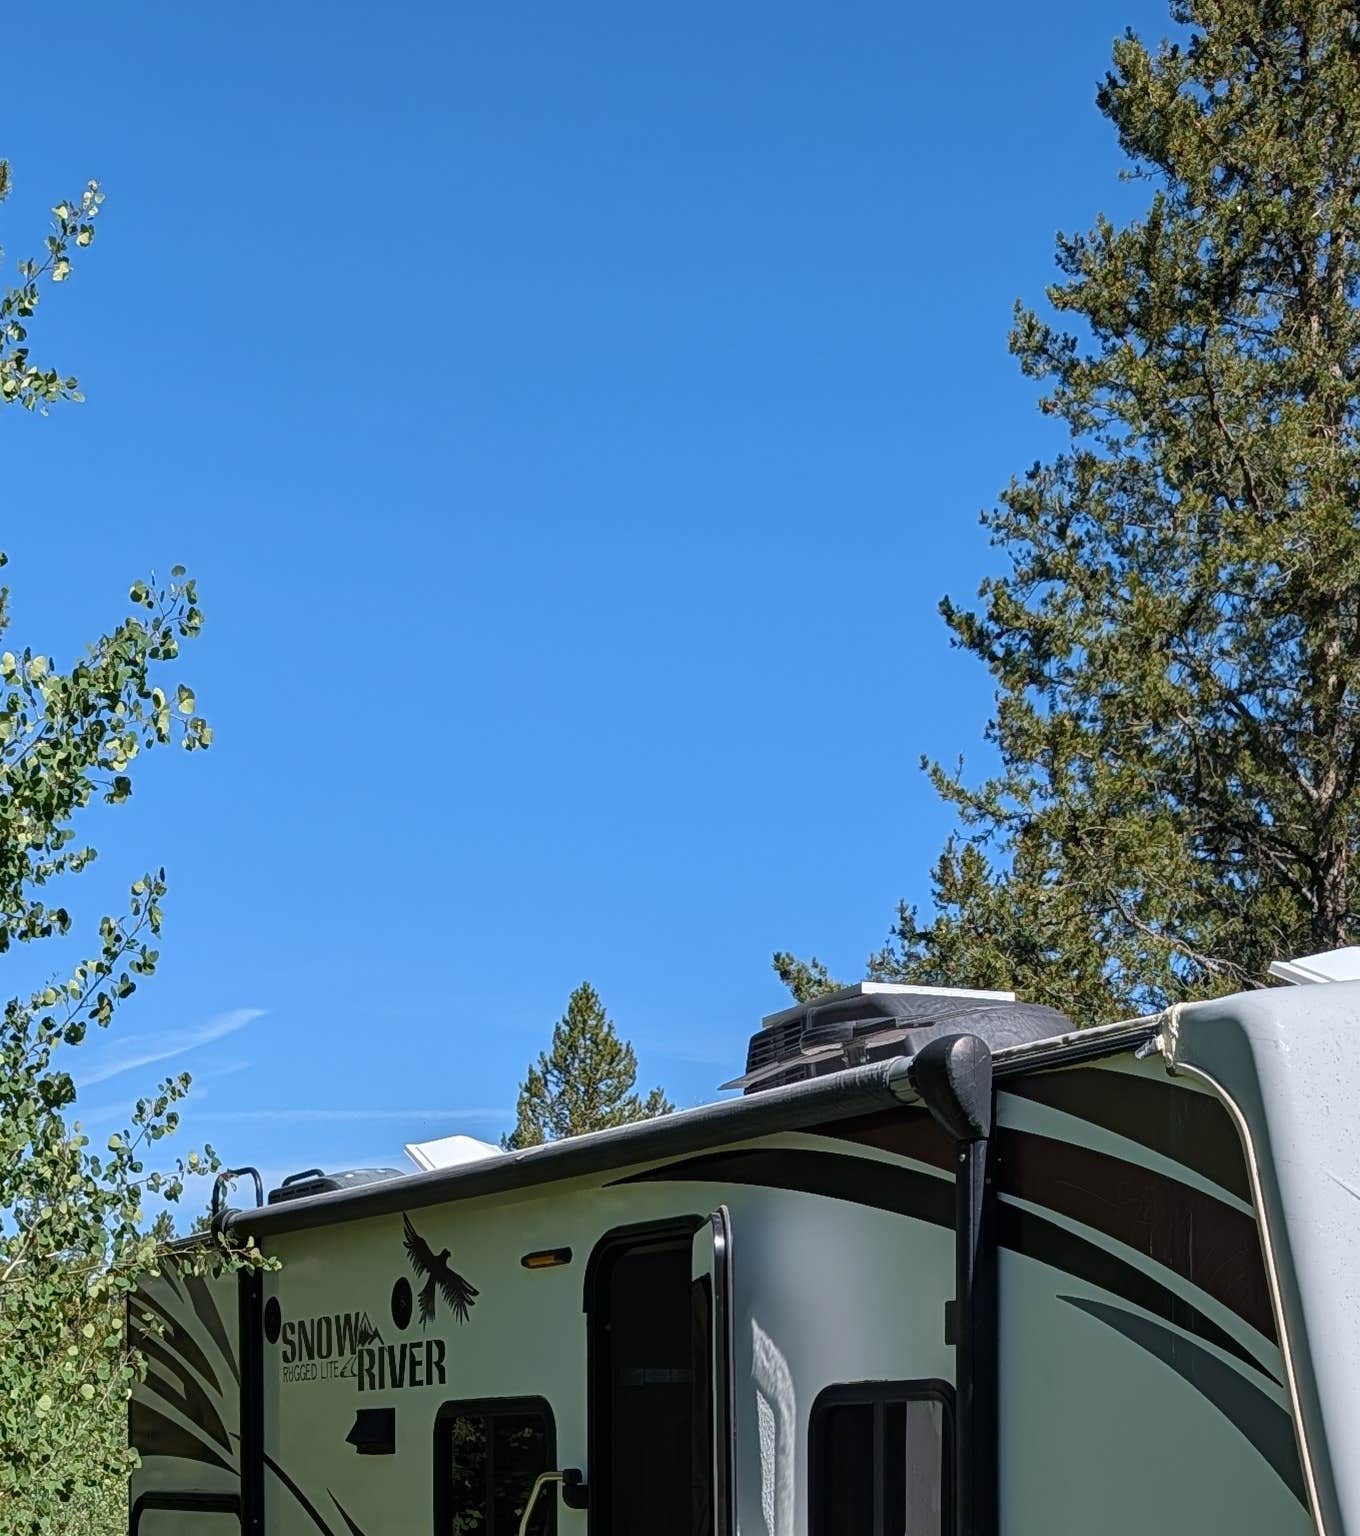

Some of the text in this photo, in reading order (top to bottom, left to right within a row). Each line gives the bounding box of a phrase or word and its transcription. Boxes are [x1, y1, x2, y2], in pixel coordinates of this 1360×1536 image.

[282, 1312, 359, 1363] SNOW
[283, 1360, 340, 1383] RUGGED LITE
[357, 1339, 446, 1392] RIVER
